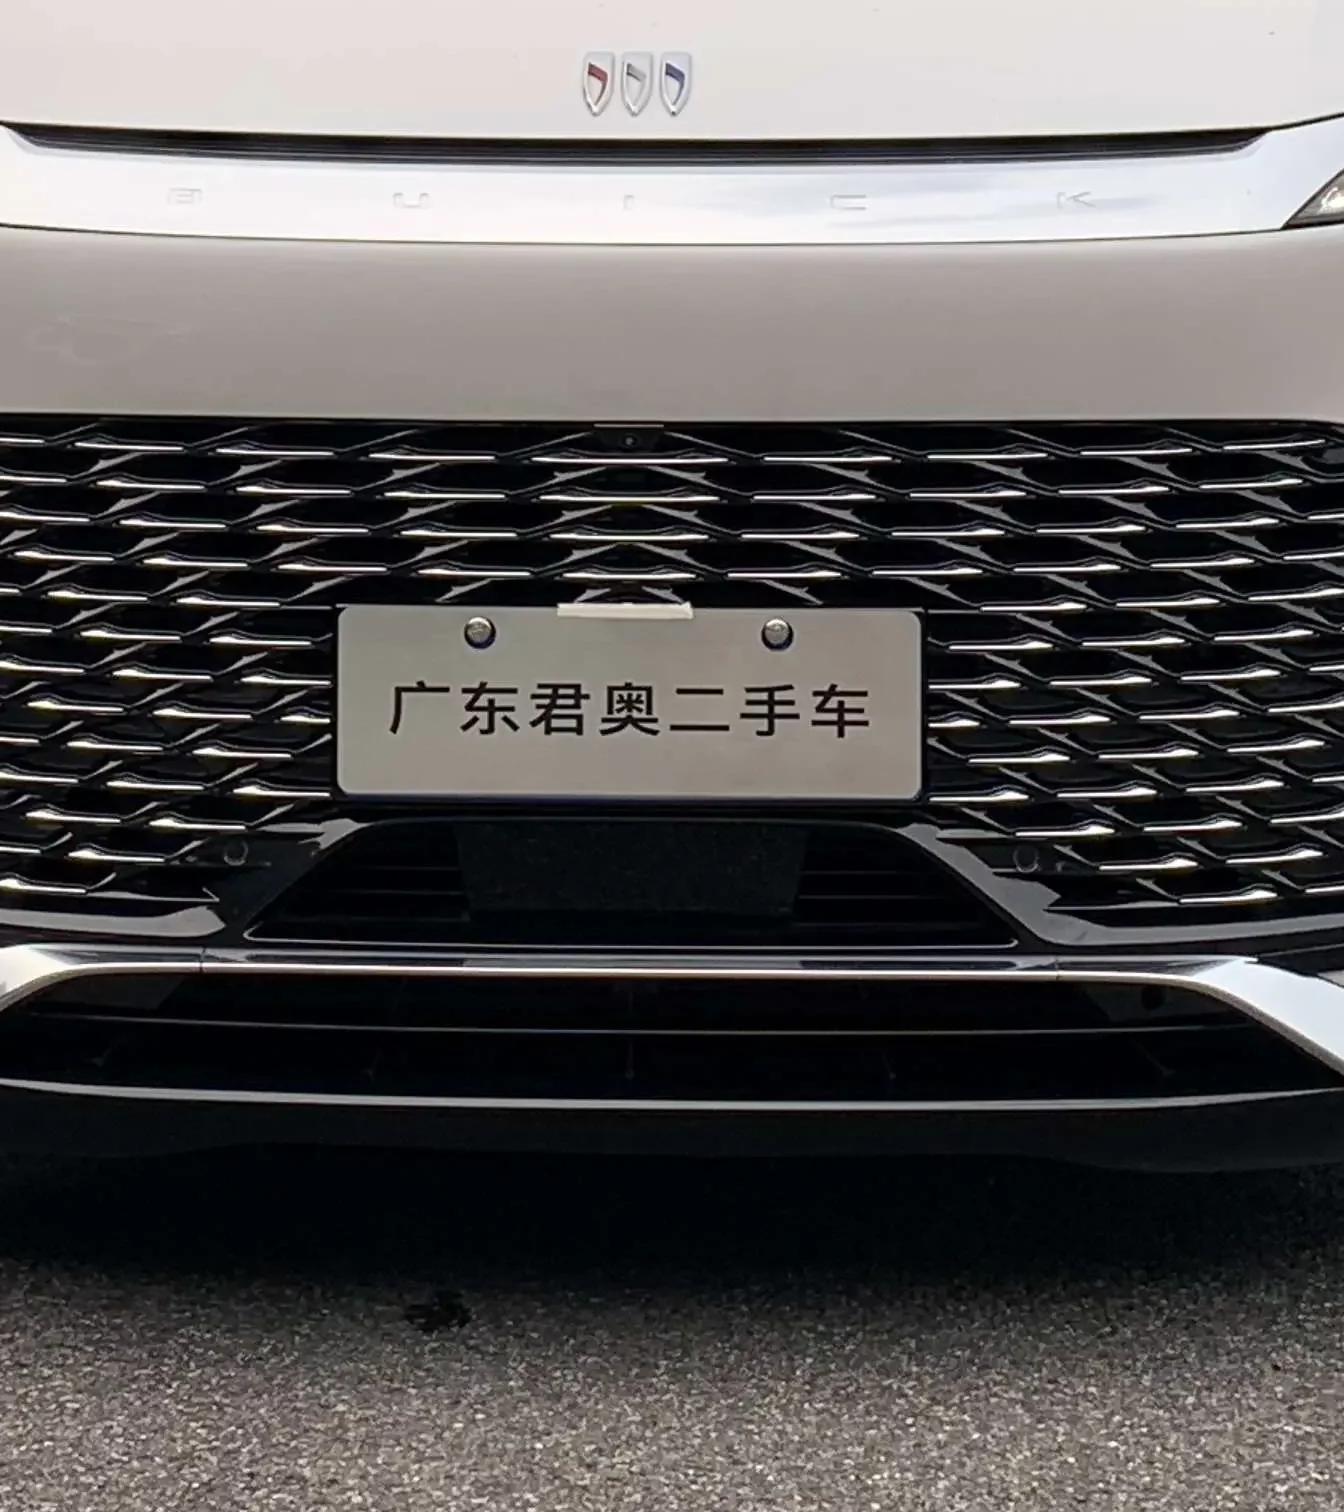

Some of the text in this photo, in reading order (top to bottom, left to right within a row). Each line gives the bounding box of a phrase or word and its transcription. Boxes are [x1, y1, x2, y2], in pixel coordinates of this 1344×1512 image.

[389, 680, 870, 738] 广东君奥二手车
